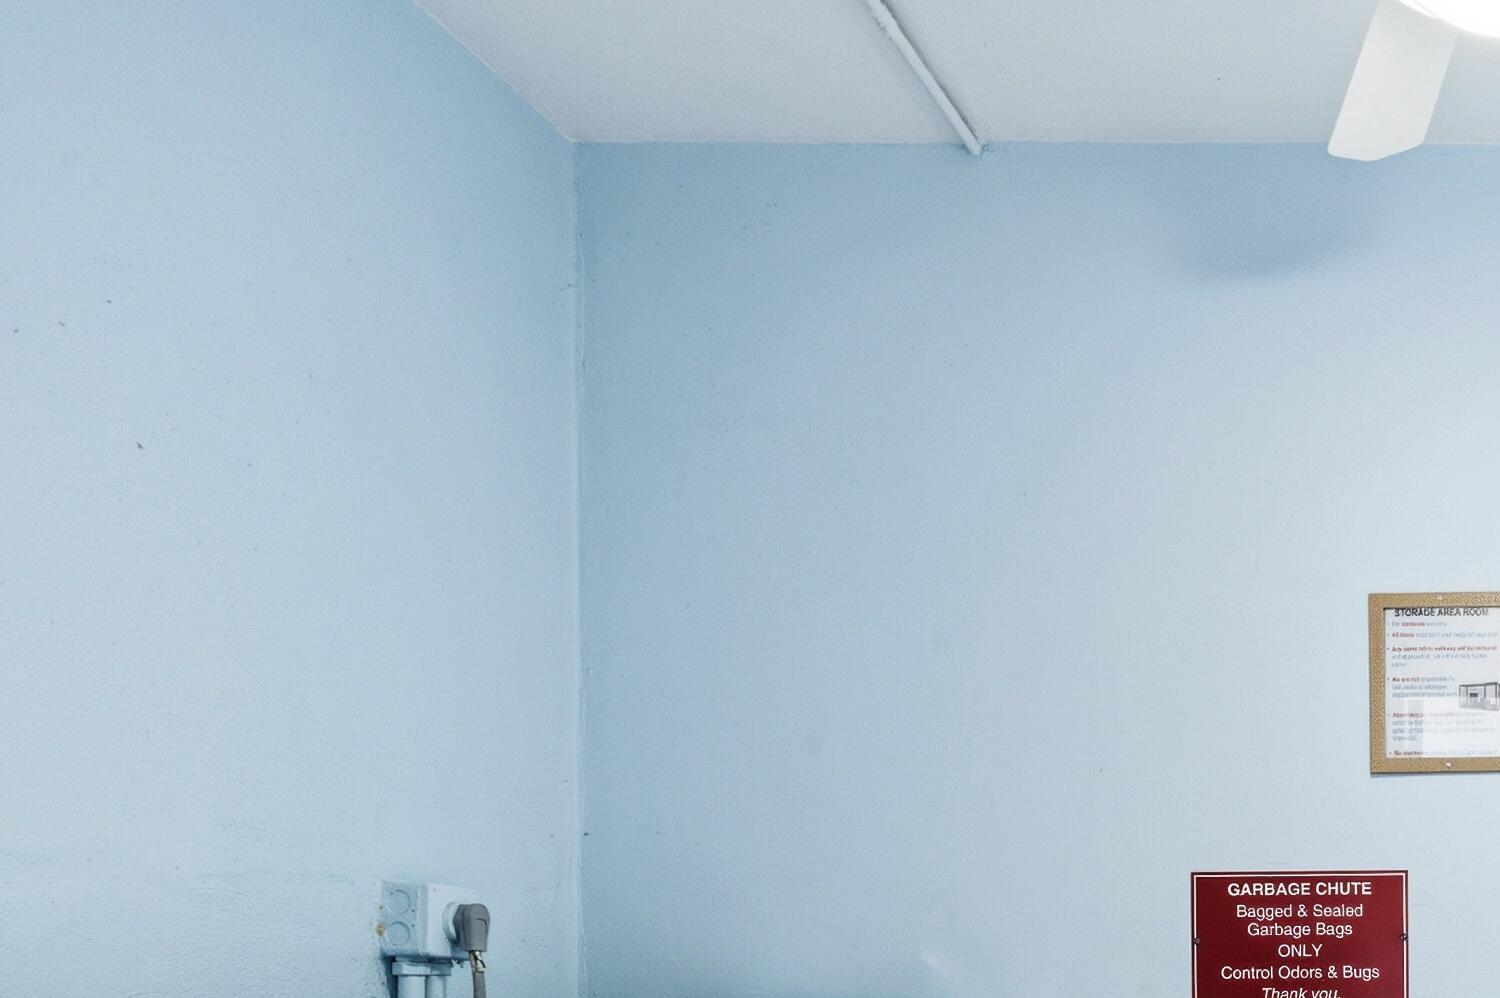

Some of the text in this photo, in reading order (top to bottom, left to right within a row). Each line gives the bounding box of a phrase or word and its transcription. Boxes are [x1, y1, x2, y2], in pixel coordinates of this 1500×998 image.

[1395, 607, 1489, 617] STORAGE AREA ROOM
[1227, 882, 1372, 896] GARBAGE CHUTE
[1236, 904, 1363, 920] Bagged & Sealed
[1247, 923, 1353, 938] Garbage Bags
[1278, 943, 1323, 958] ONLY
[1221, 966, 1380, 981] Control Odors & Bugs
